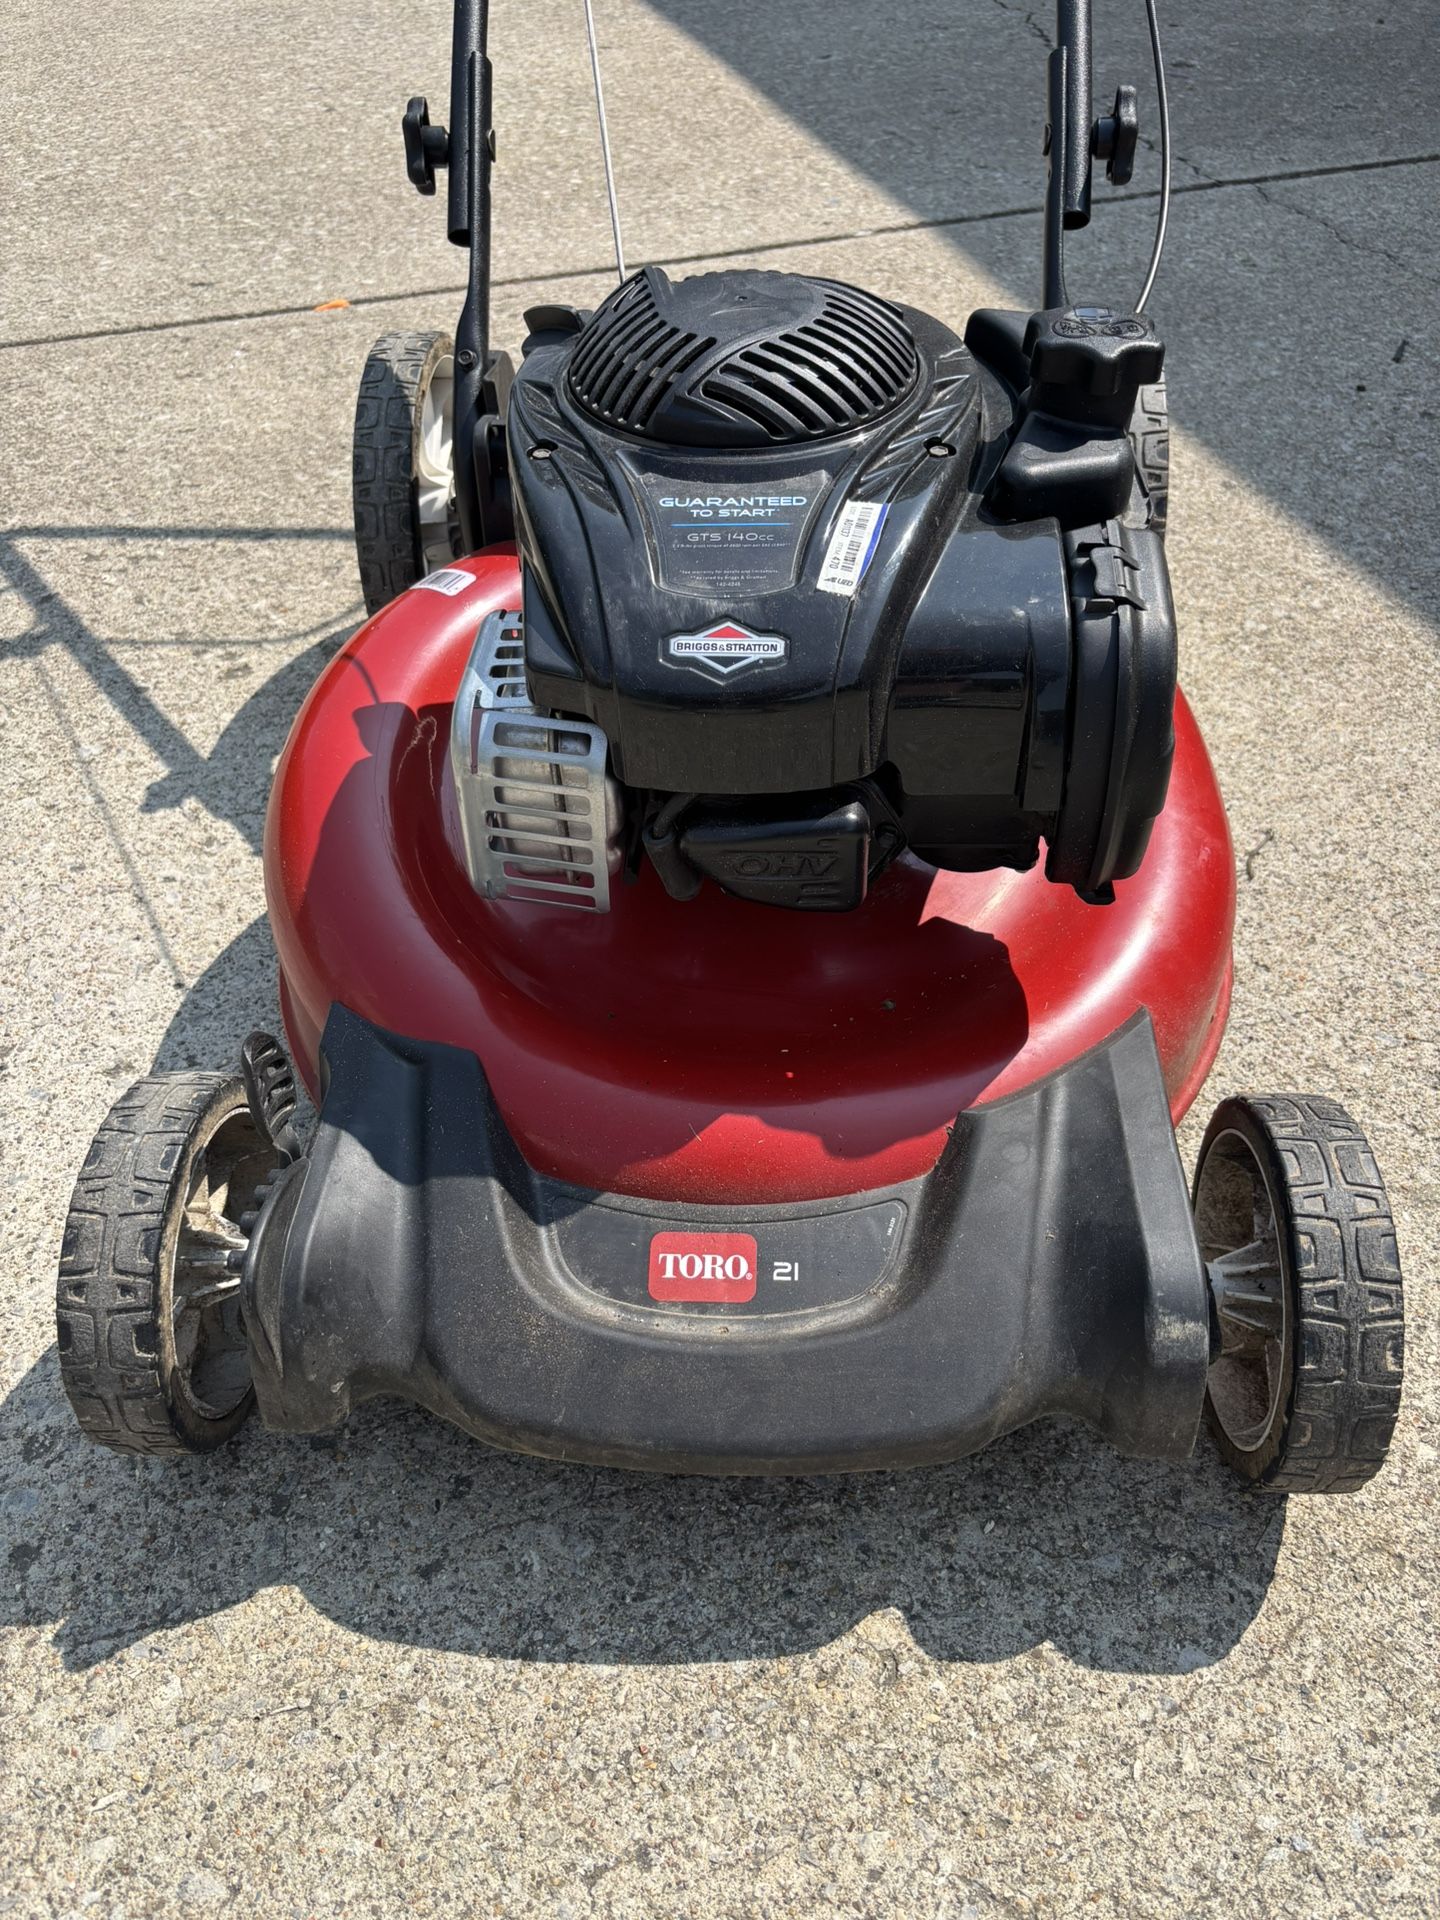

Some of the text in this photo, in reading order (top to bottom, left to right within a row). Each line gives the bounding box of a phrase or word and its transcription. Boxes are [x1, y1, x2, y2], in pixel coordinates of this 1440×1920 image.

[658, 496, 808, 508] GUARANTEED
[690, 509, 714, 518] TO
[687, 532, 775, 542] GTS 140cc
[829, 556, 841, 570] 470
[676, 642, 778, 652] BRIGGS&STRATTON
[735, 855, 840, 877] OHV
[772, 1261, 799, 1281] 21
